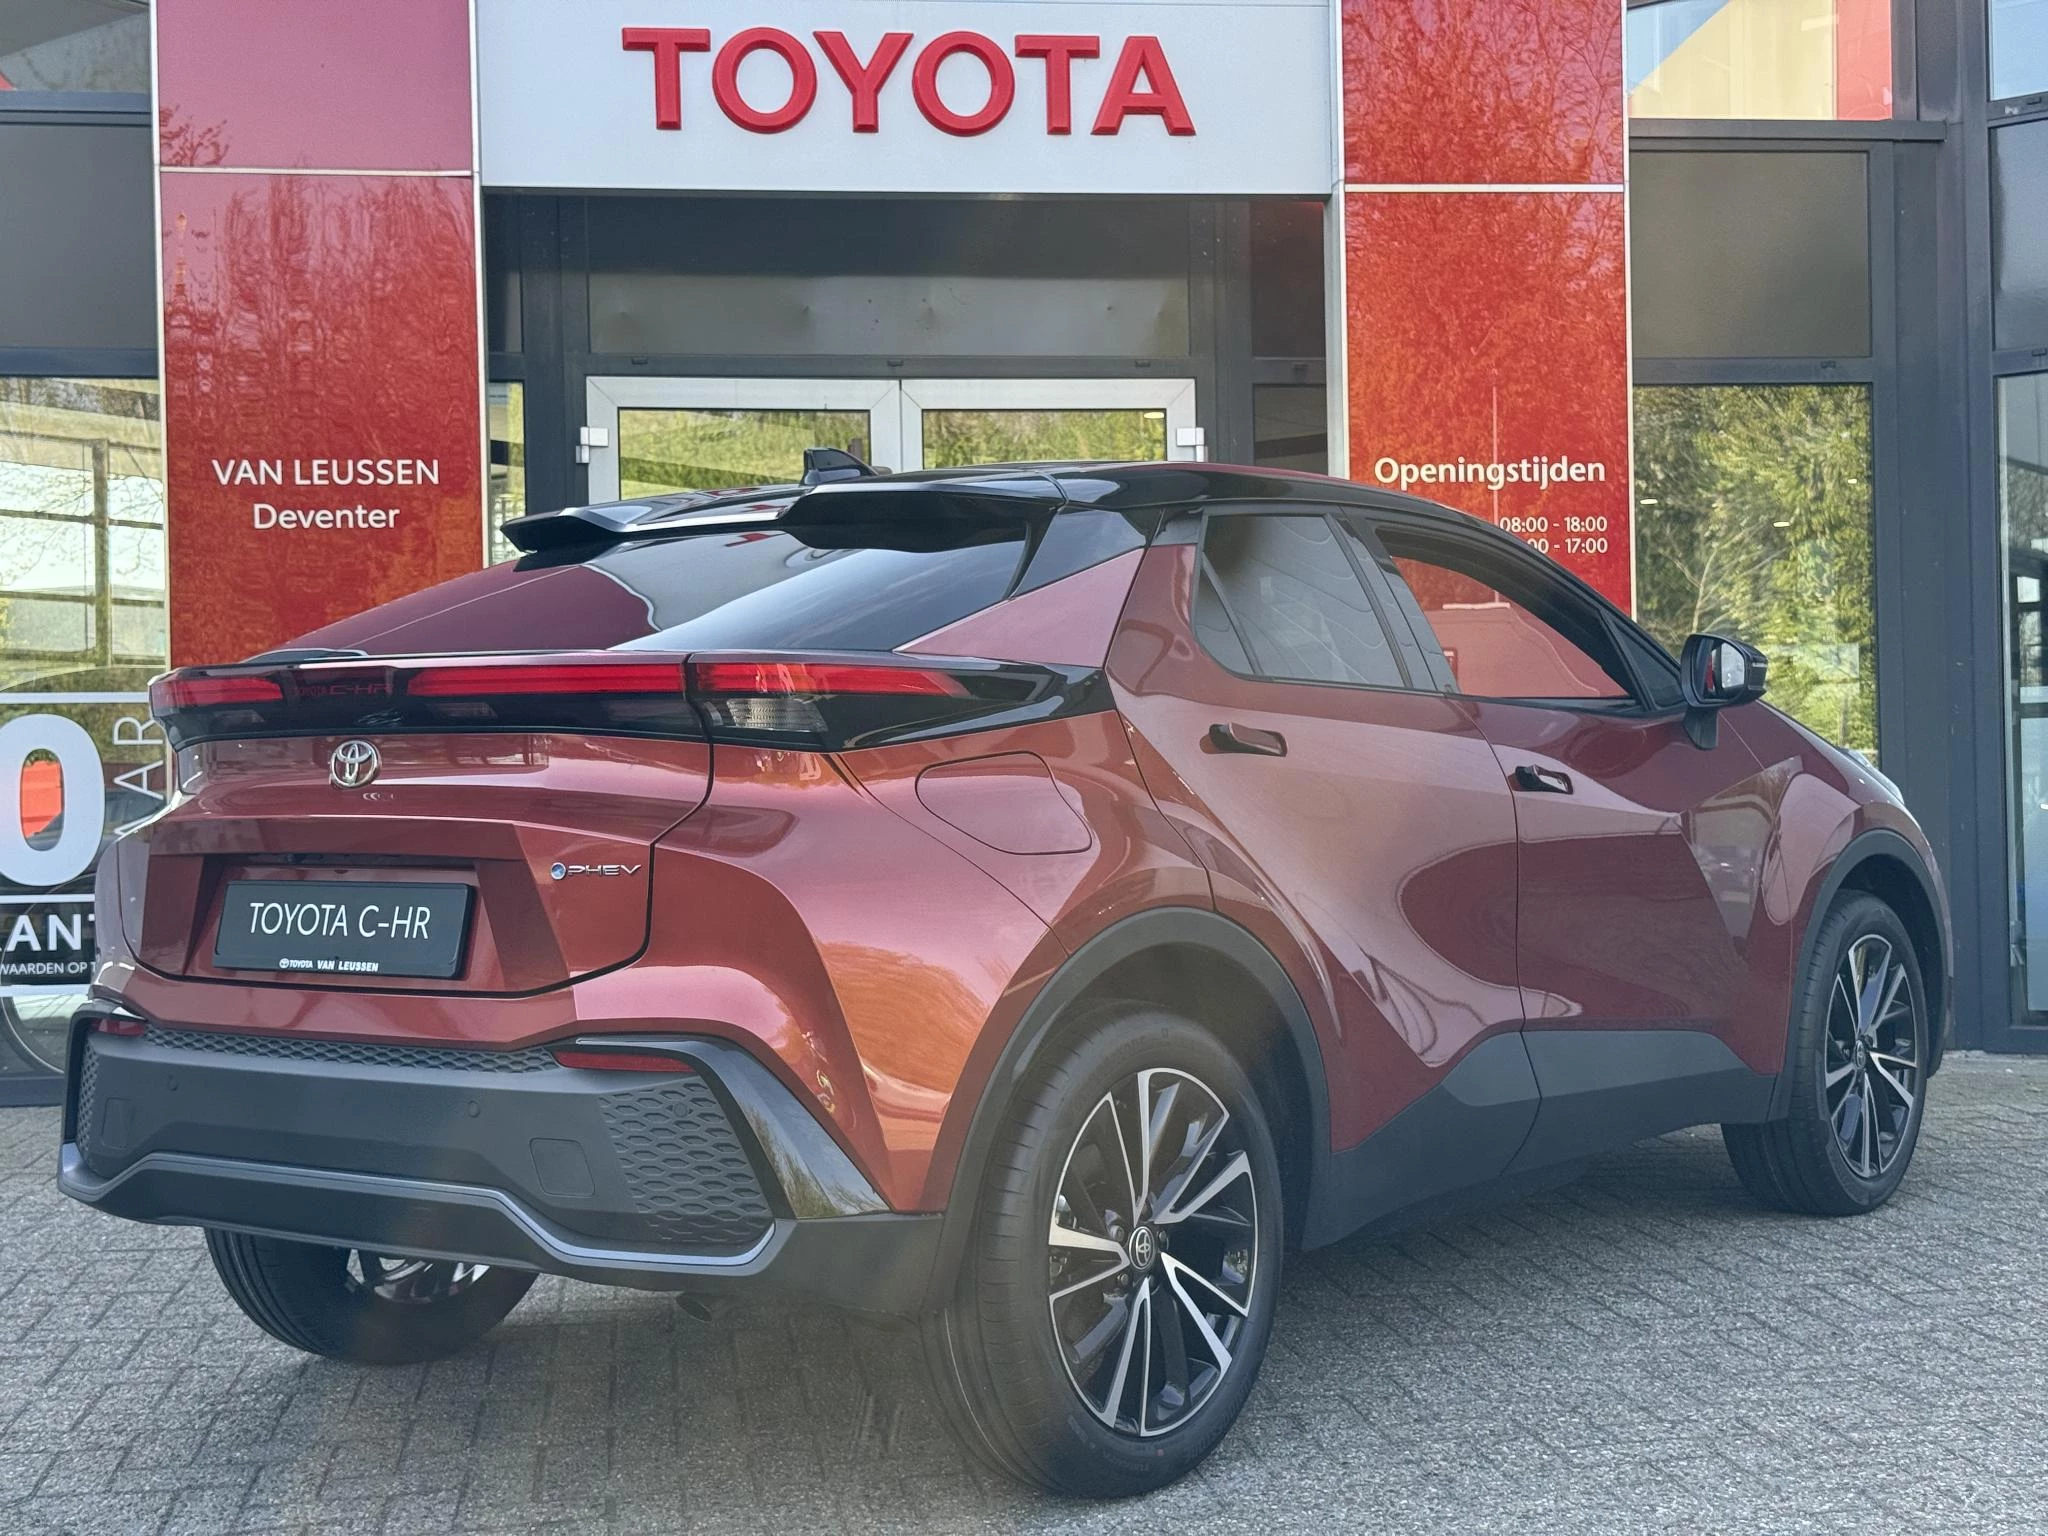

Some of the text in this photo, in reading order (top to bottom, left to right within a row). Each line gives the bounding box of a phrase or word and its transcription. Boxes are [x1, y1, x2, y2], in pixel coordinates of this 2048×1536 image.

[622, 27, 1196, 136] TOYOTA
[211, 458, 440, 486] VAN LEUSSEN
[1374, 456, 1606, 491] Openingstijden
[253, 503, 400, 530] Deventer
[1500, 516, 1548, 533] 08:00
[1564, 516, 1608, 532] 18:00
[1565, 537, 1608, 554] 17:00
[568, 864, 641, 876] PHEV
[250, 902, 431, 939] TOYOTA C-HR
[68, 962, 87, 973] OP
[290, 959, 378, 972] TOYOTA VAN LEUSSEN
